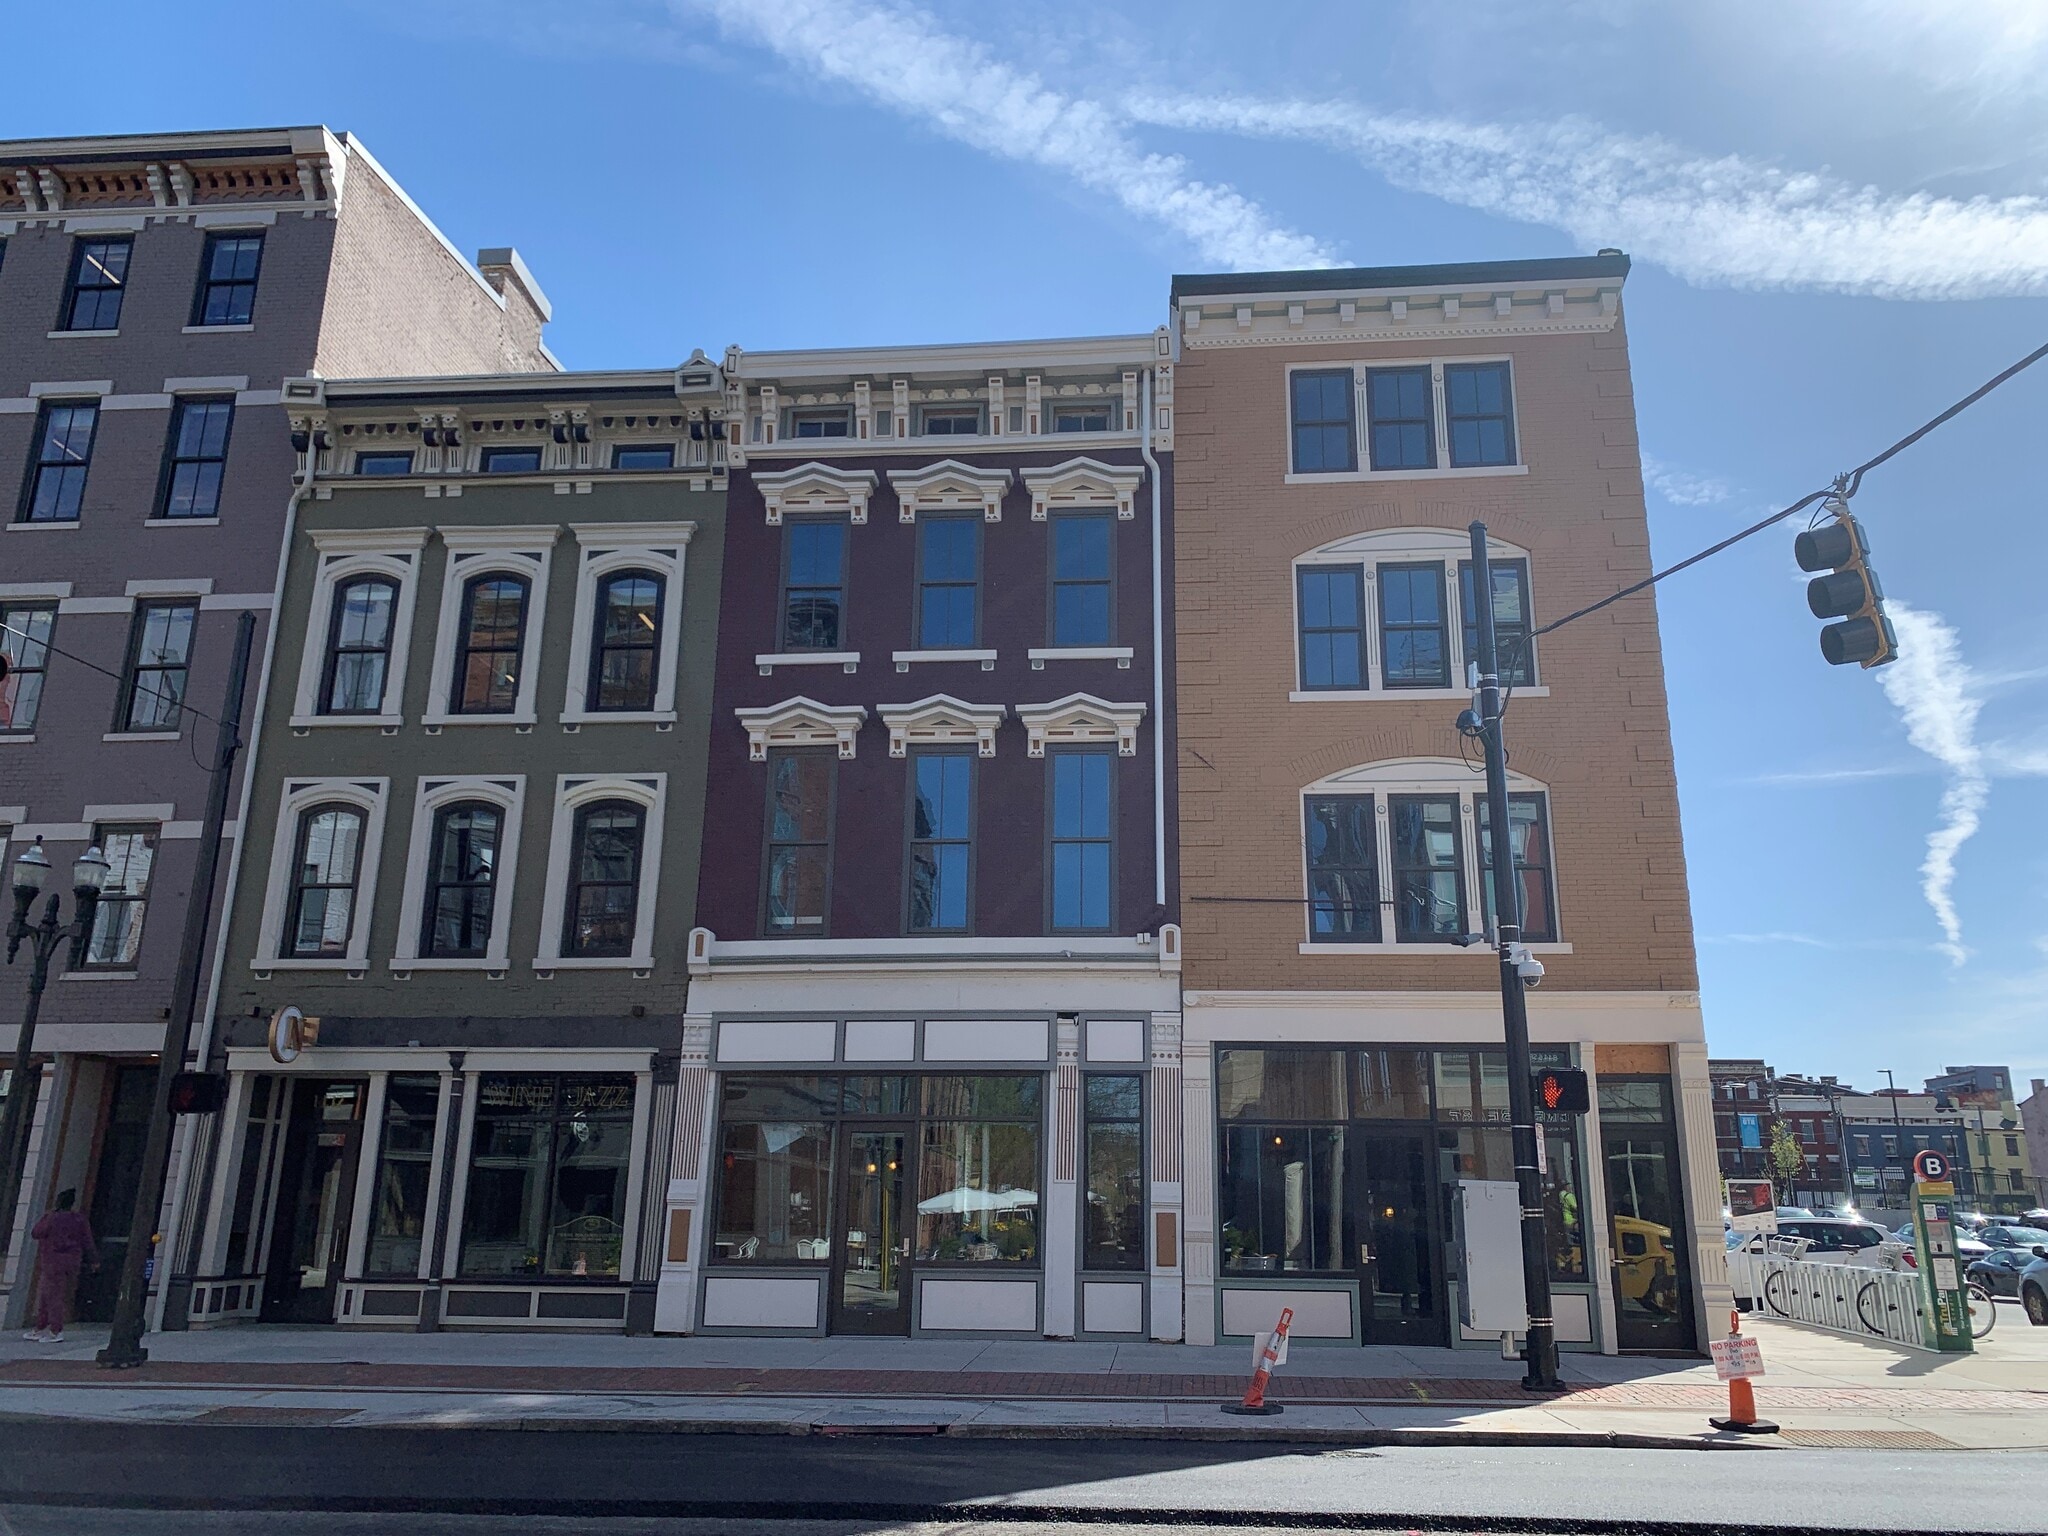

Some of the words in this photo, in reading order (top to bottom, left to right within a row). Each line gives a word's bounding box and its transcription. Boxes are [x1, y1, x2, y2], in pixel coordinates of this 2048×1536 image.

[486, 1086, 553, 1107] WINE
[567, 1086, 629, 1107] JAZZ
[1925, 1157, 1942, 1175] B
[1711, 1343, 1723, 1351] NO
[1724, 1339, 1757, 1349] PARKING
